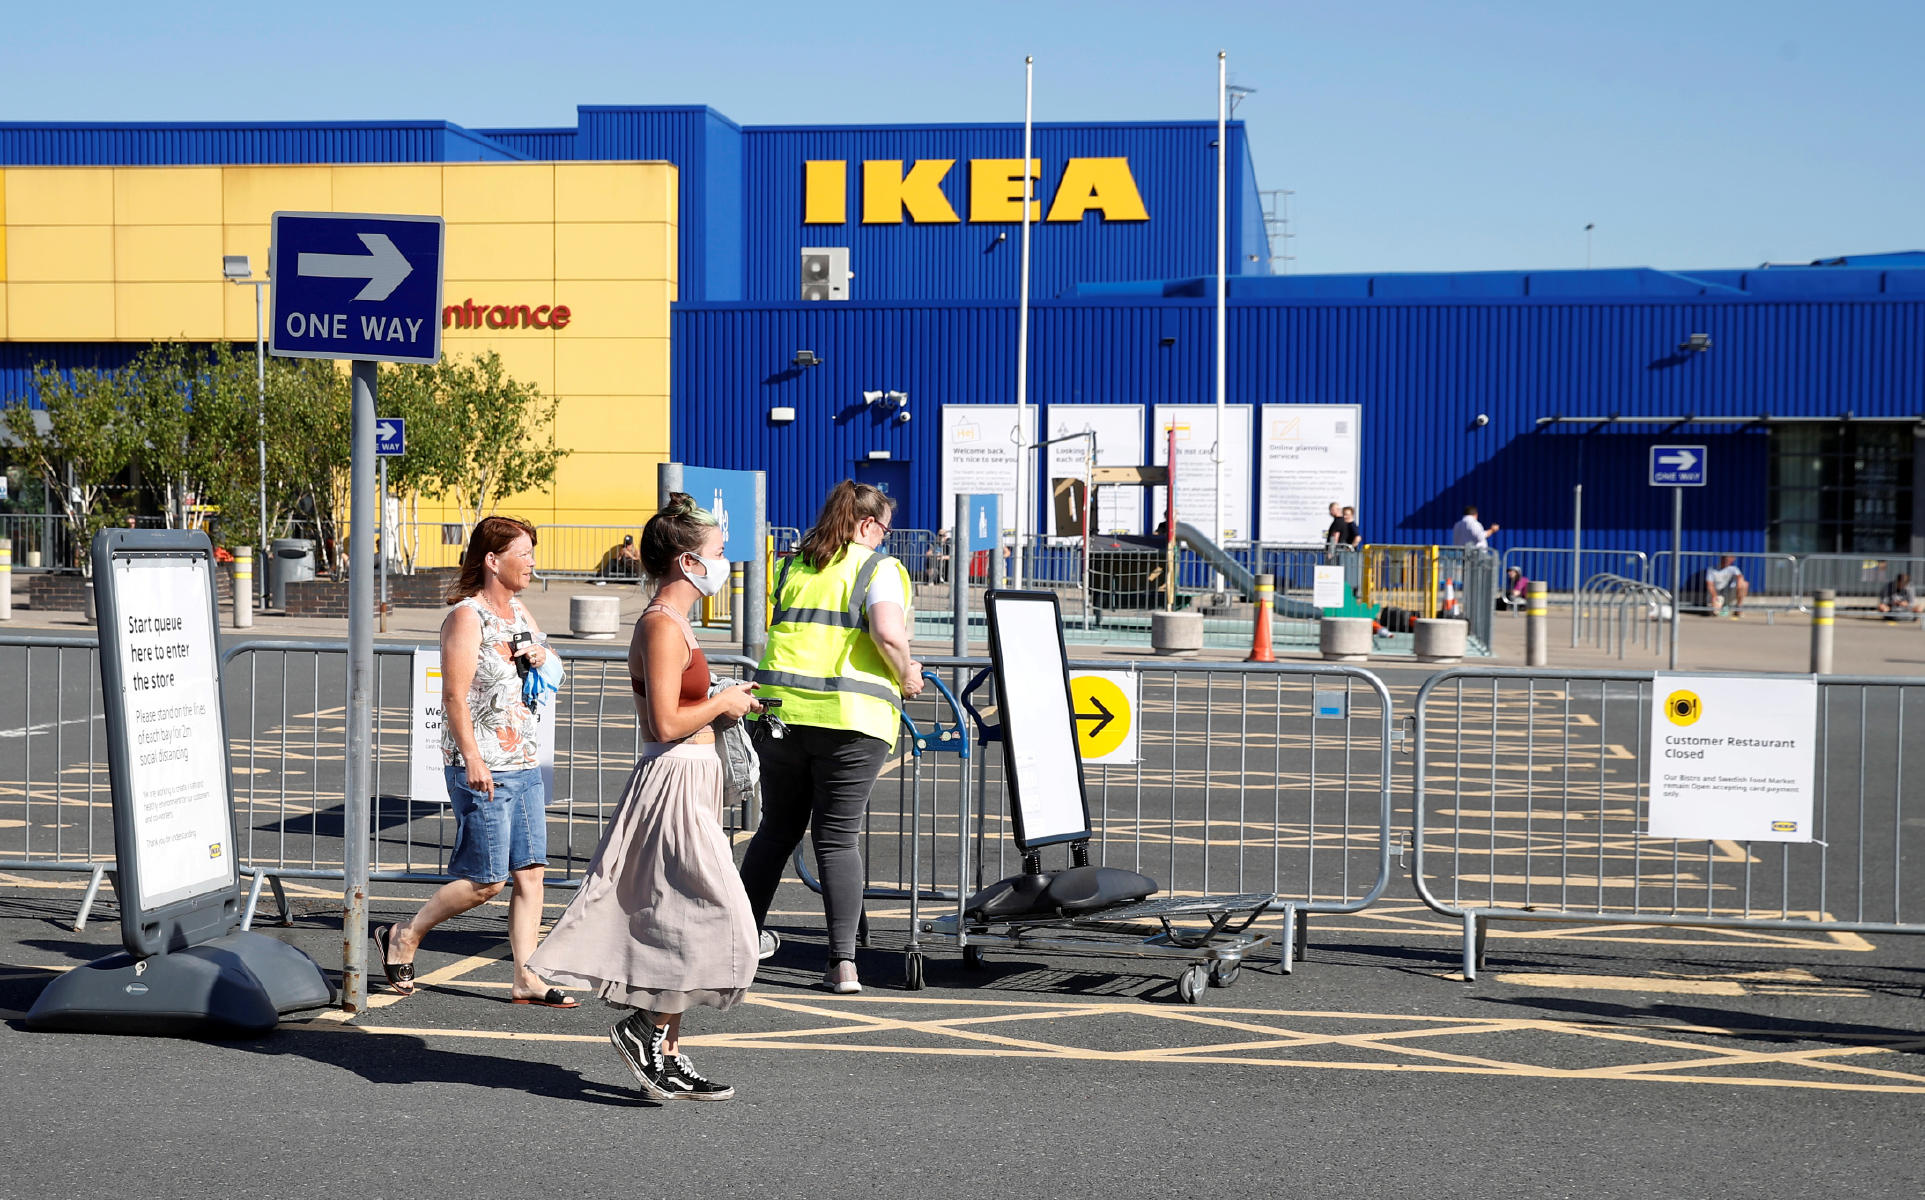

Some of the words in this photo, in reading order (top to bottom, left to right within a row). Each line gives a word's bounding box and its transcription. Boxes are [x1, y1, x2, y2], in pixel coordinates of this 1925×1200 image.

[804, 157, 1150, 224] IKEA
[442, 298, 571, 330] ntrance
[286, 312, 348, 339] ONE
[361, 315, 423, 343] WAY
[381, 443, 400, 451] WAY
[1056, 447, 1085, 456] Looking
[1295, 444, 1328, 453] planning
[1655, 472, 1677, 481] ONE
[1679, 472, 1701, 481] WAY
[129, 616, 152, 634] Start
[154, 617, 182, 637] queue
[131, 643, 153, 662] here
[154, 643, 165, 660] to
[166, 642, 190, 659] enter
[133, 672, 149, 691] the
[151, 672, 175, 689] store
[136, 708, 156, 723] Please
[157, 705, 174, 721] stand
[182, 704, 193, 717] the
[138, 729, 145, 745] of
[145, 728, 160, 744] each
[160, 727, 172, 745] bay
[1665, 735, 1724, 746] Customer
[1727, 737, 1795, 748] Restaurant
[140, 749, 157, 767] social
[159, 745, 189, 762] distancing
[1665, 749, 1704, 759] Closed
[1718, 775, 1747, 783] Swedish
[1691, 783, 1711, 791] Open
[1712, 784, 1748, 793] accepting
[1766, 786, 1800, 794] payment
